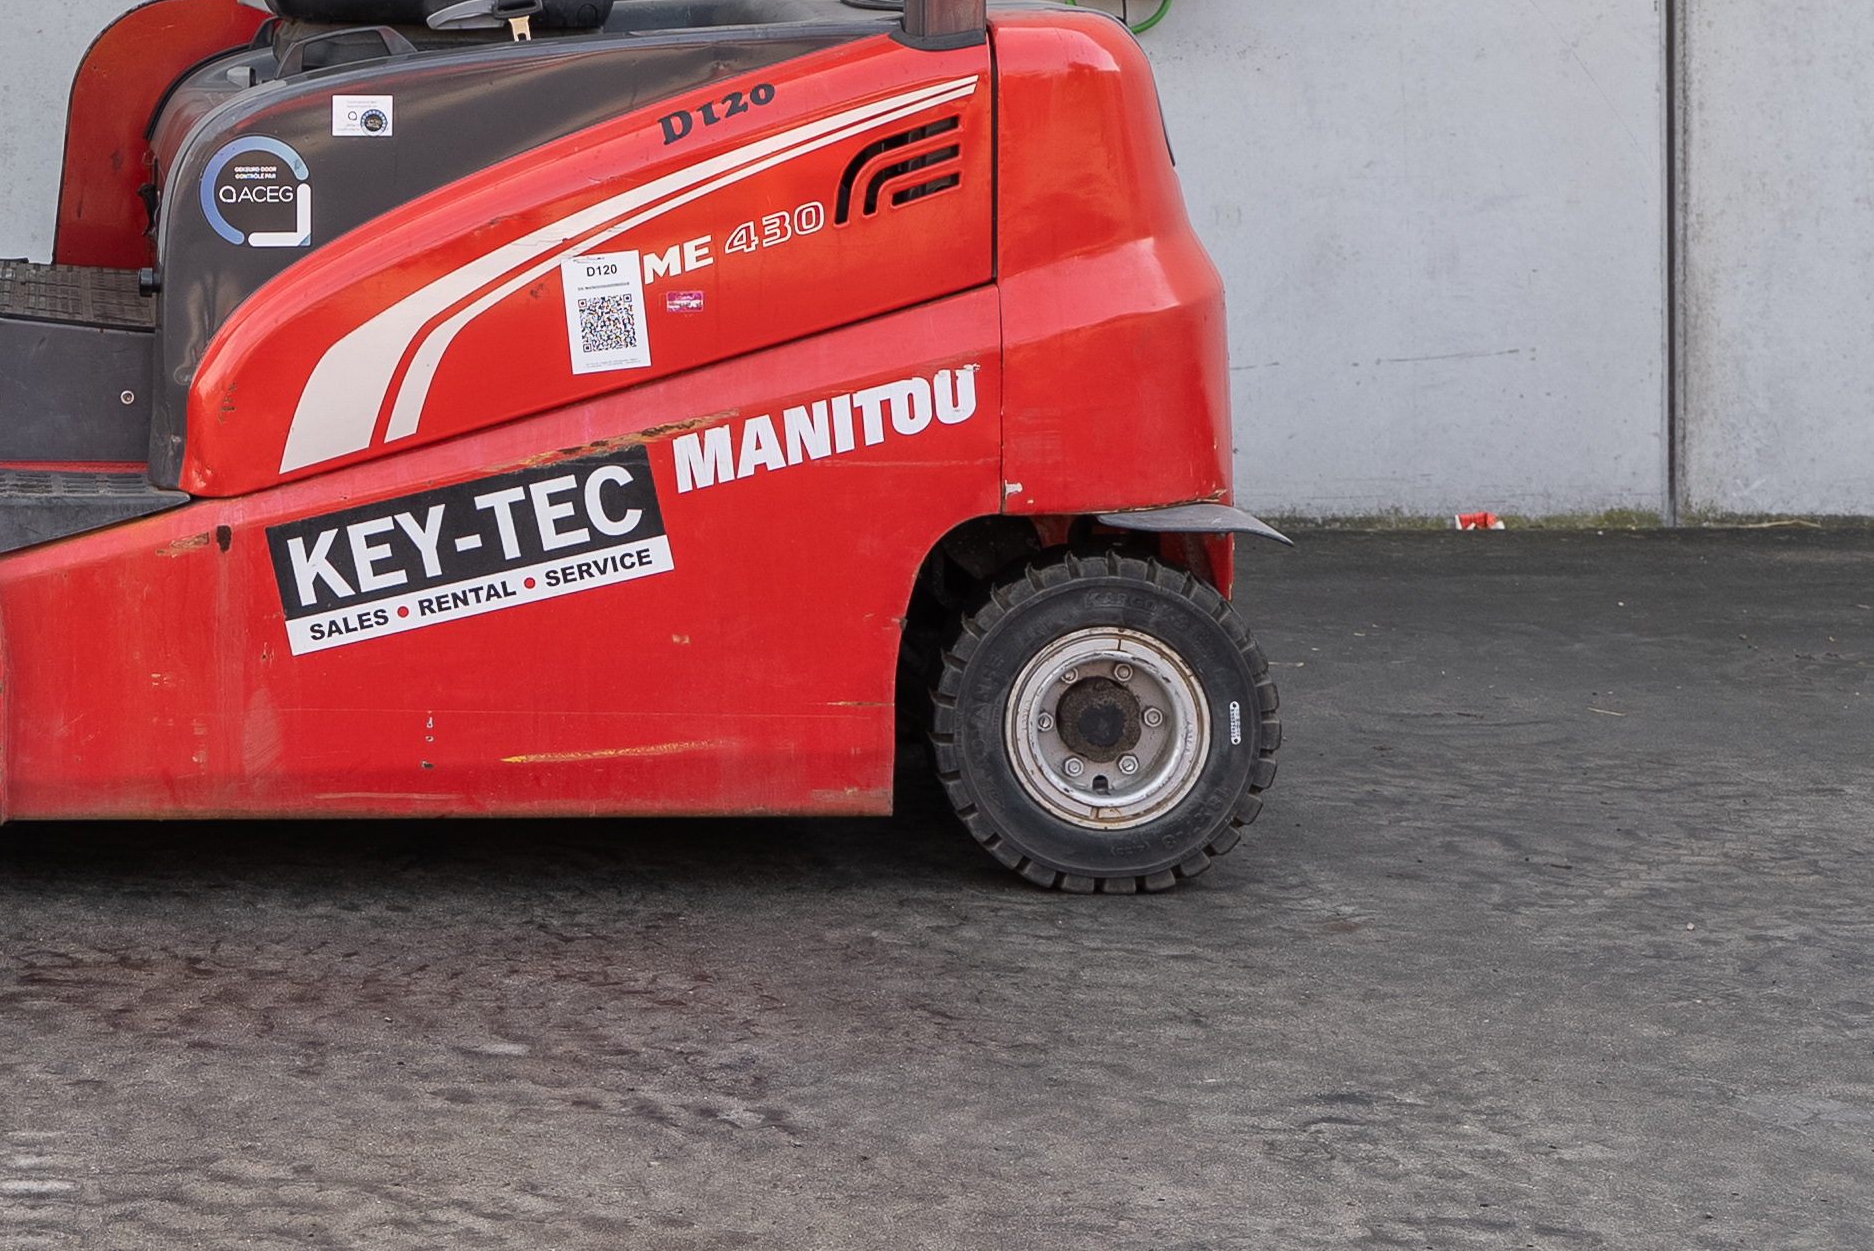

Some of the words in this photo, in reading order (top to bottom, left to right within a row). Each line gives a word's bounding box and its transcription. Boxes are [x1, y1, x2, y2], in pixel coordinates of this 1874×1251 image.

[238, 186, 293, 203] ACEG
[586, 264, 617, 277] D120
[642, 235, 714, 285] ME
[725, 201, 825, 255] 430
[672, 364, 978, 494] MANITOU
[286, 464, 643, 608] KEY-TEC
[309, 608, 389, 641] SALES
[418, 580, 517, 616] RENTAL
[544, 548, 653, 587] SERVICE
